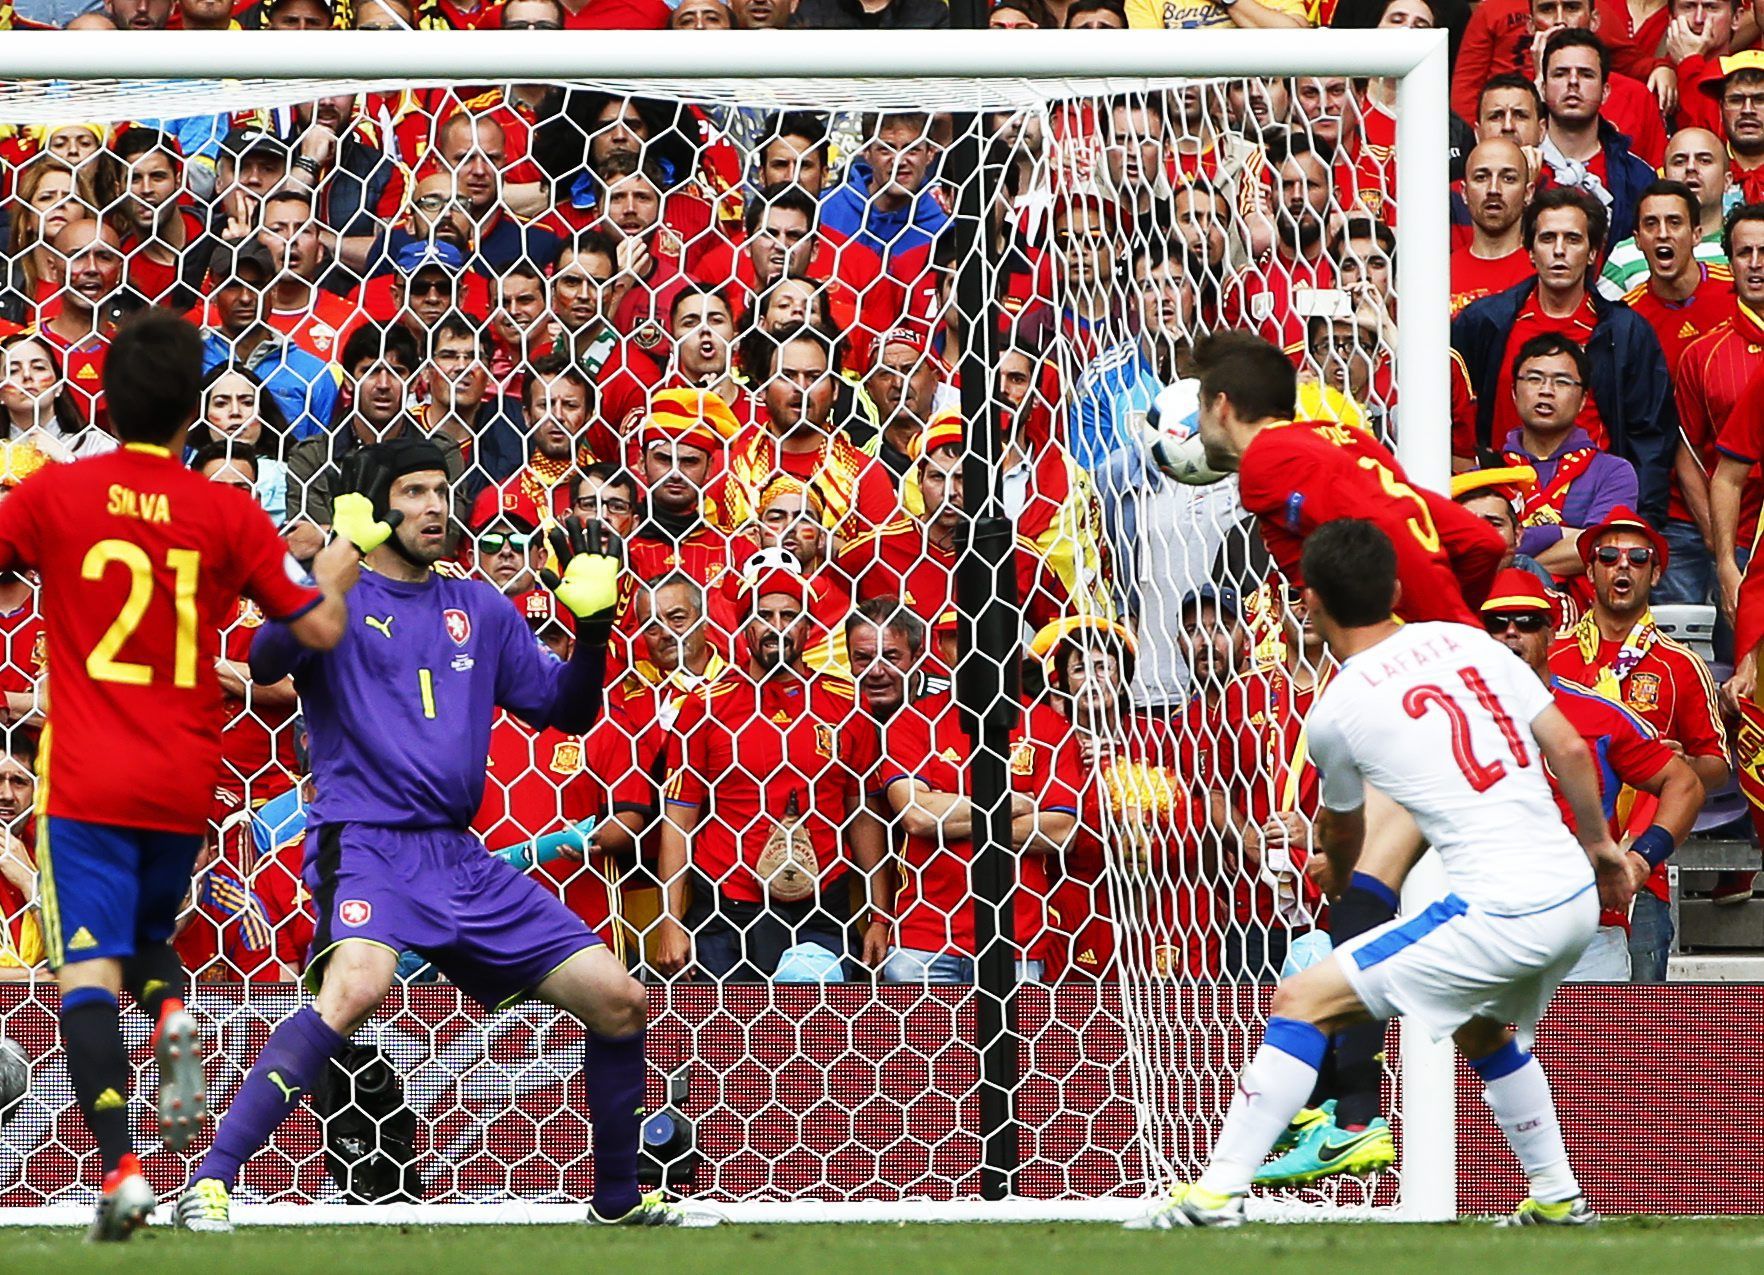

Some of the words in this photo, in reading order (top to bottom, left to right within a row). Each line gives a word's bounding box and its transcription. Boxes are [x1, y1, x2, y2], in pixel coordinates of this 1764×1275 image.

[106, 483, 172, 525] SILVA
[1357, 455, 1440, 553] 3
[81, 538, 201, 690] 21
[418, 668, 437, 719] 1
[1360, 634, 1463, 687] LAFATA
[1401, 666, 1530, 793] 21
